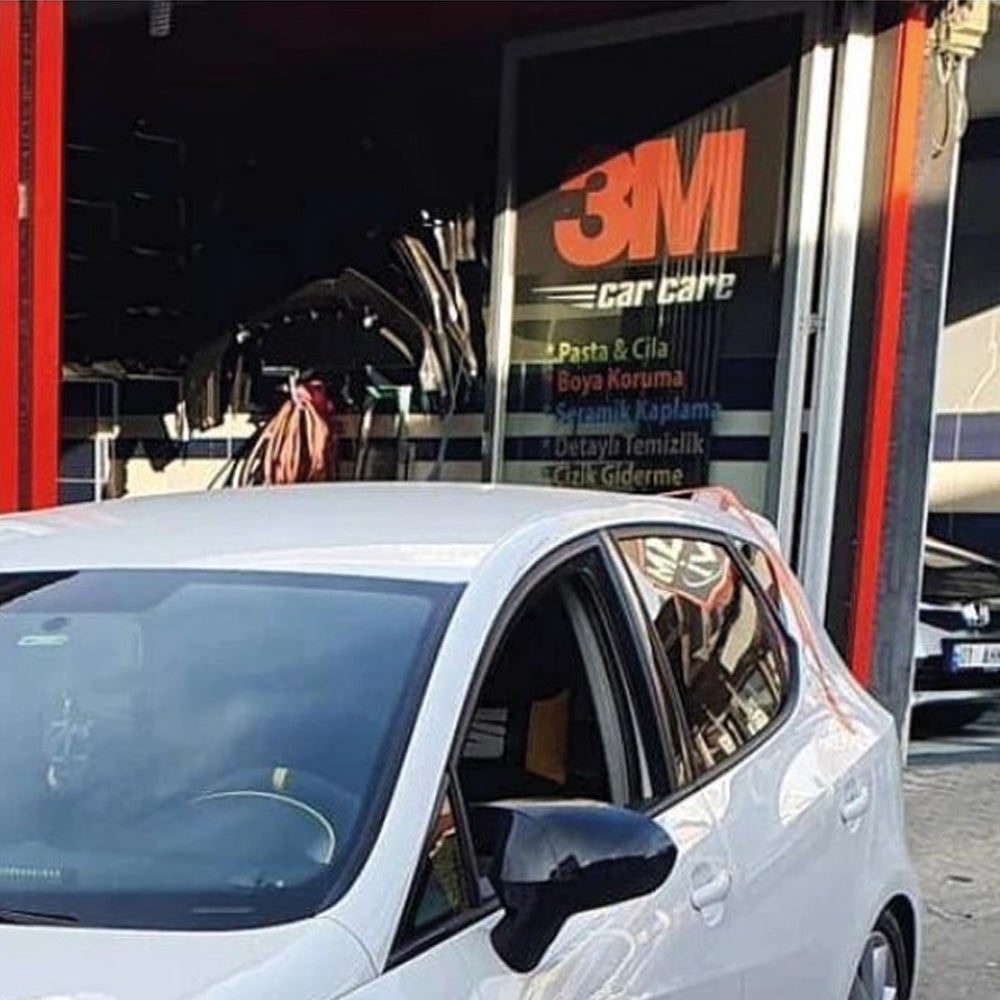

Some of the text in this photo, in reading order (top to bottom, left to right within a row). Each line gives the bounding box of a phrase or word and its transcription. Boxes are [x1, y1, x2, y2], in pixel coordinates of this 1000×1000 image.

[553, 128, 745, 266] 3M
[597, 272, 736, 309] car care
[558, 336, 669, 364] Pasta & Cila
[606, 367, 684, 391] Koruma
[600, 462, 685, 487] Giderme
